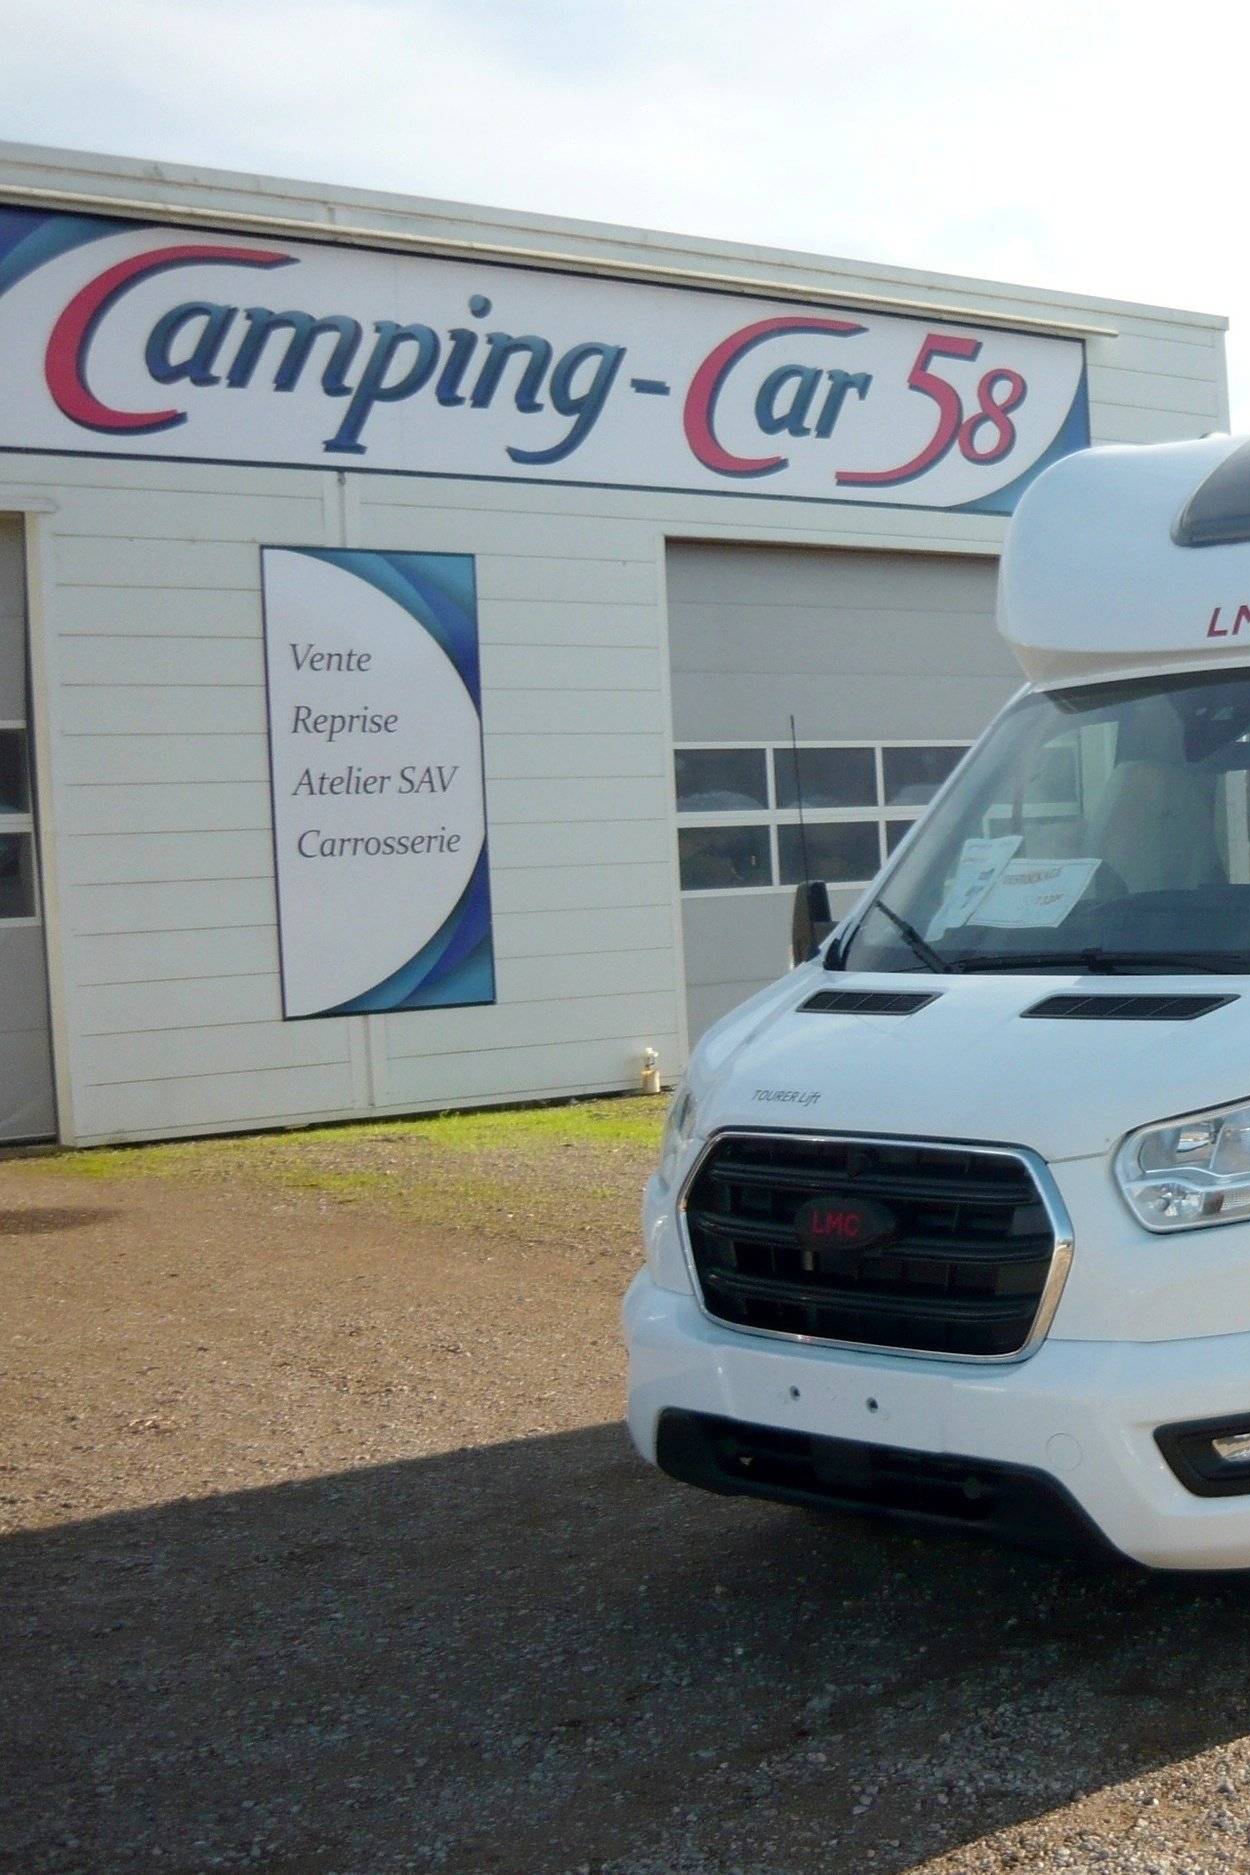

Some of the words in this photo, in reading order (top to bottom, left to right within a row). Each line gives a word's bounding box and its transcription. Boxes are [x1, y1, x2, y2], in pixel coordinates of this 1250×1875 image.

[44, 245, 872, 478] Camping-Car
[834, 333, 1028, 486] 58
[289, 643, 372, 672] Vente
[291, 705, 399, 742] Reprise
[291, 766, 391, 796] Atelier
[398, 765, 459, 794] SAV
[298, 826, 461, 858] Carrosserie
[752, 1089, 800, 1102] TOURER
[810, 1212, 859, 1237] LMC
